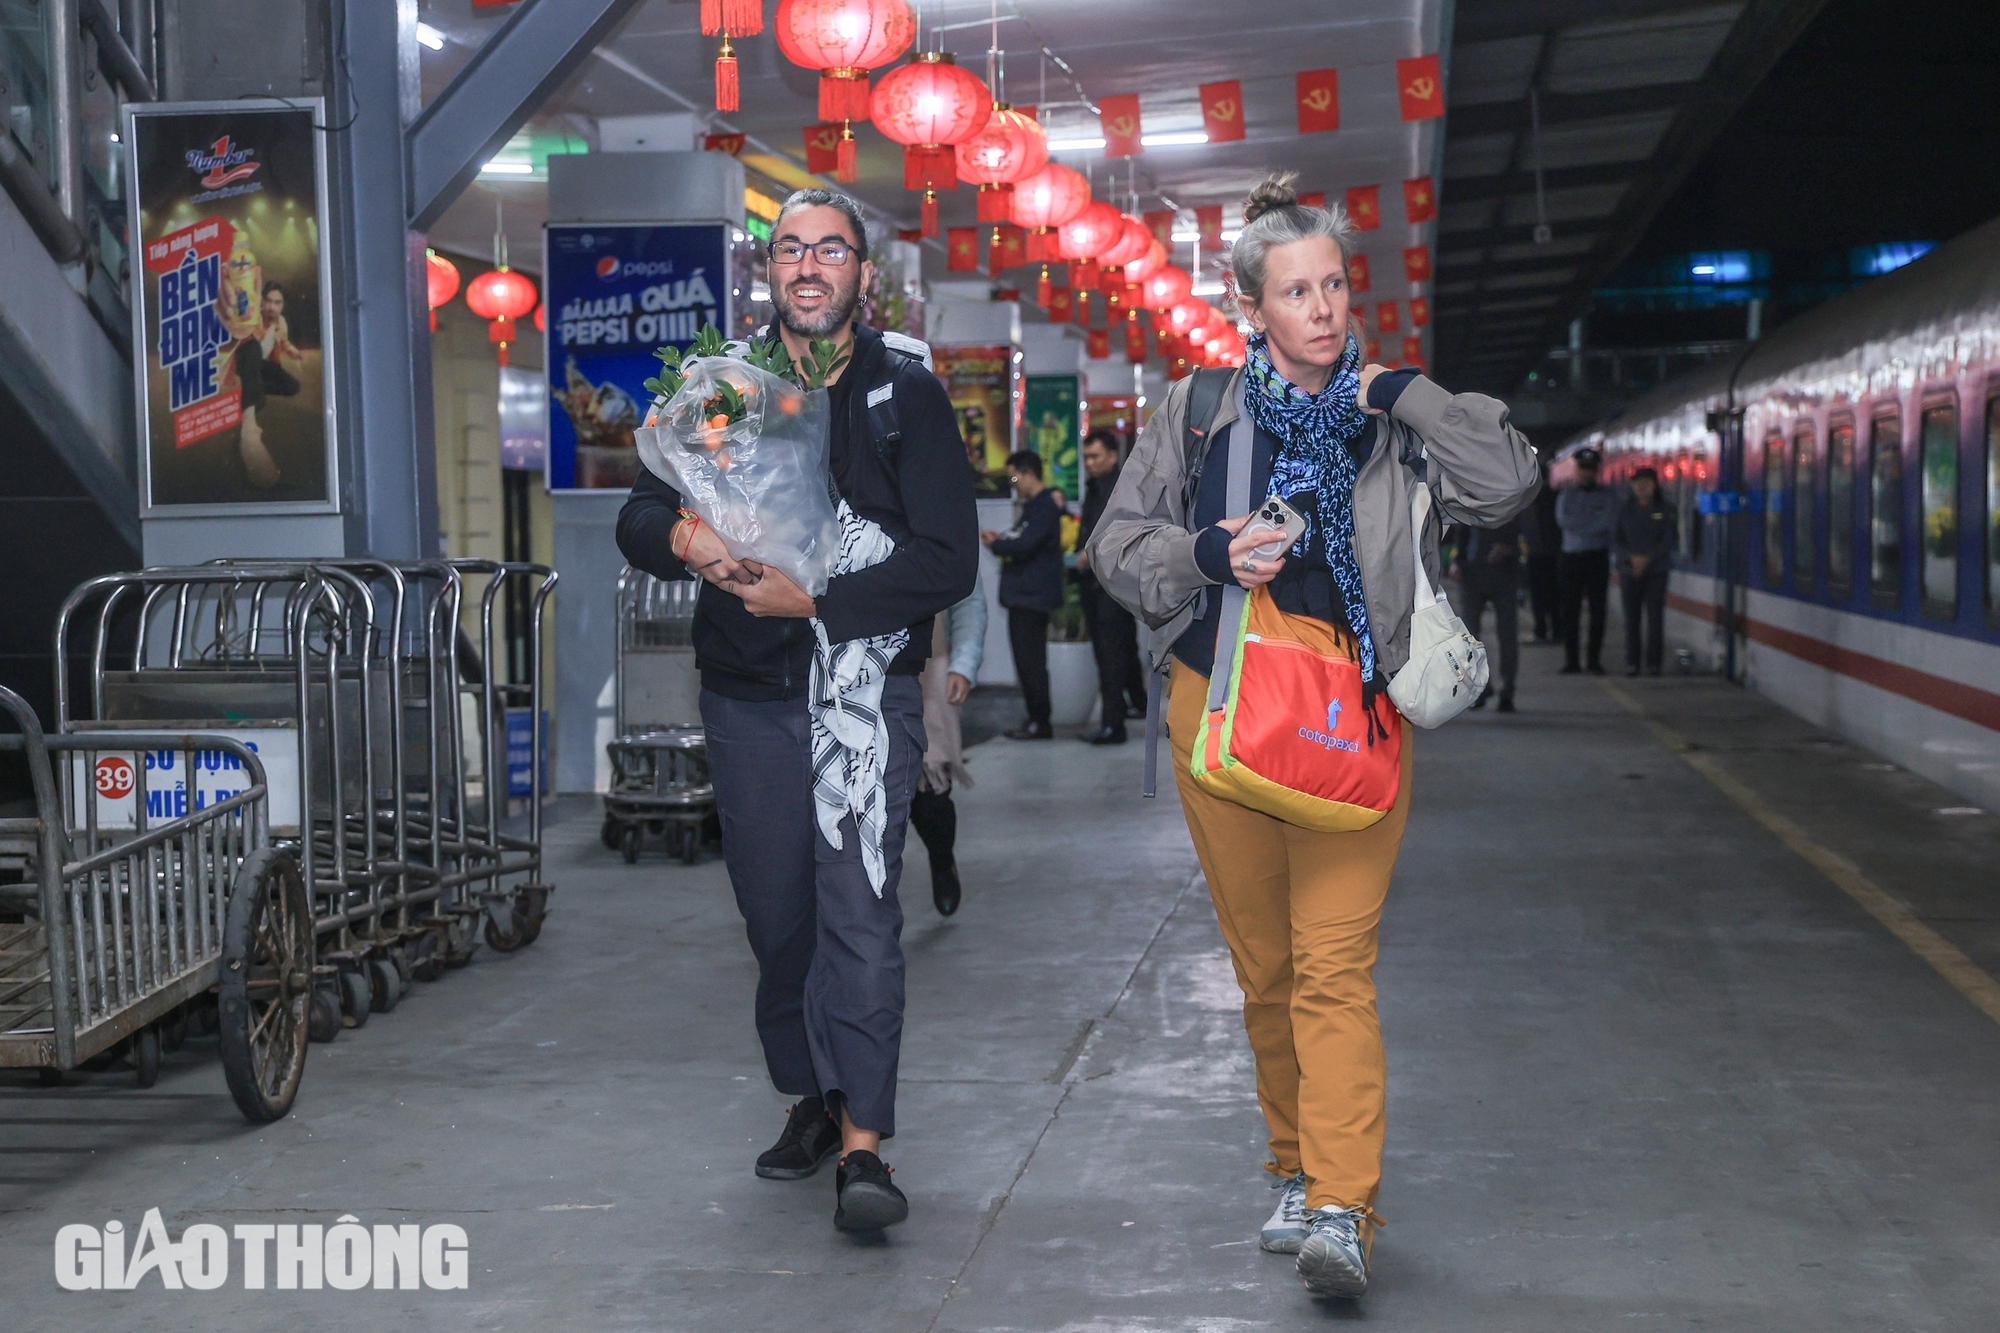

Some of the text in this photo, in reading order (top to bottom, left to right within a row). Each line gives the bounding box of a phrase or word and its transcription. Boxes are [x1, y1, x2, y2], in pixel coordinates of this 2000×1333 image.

[623, 259, 673, 277] pepsi
[159, 248, 220, 321] BỀN
[641, 267, 717, 313] QUÁ
[563, 317, 630, 346] PEPSI
[170, 341, 219, 411] MÊ
[1298, 727, 1359, 753] cotopaxi
[96, 765, 134, 791] 39
